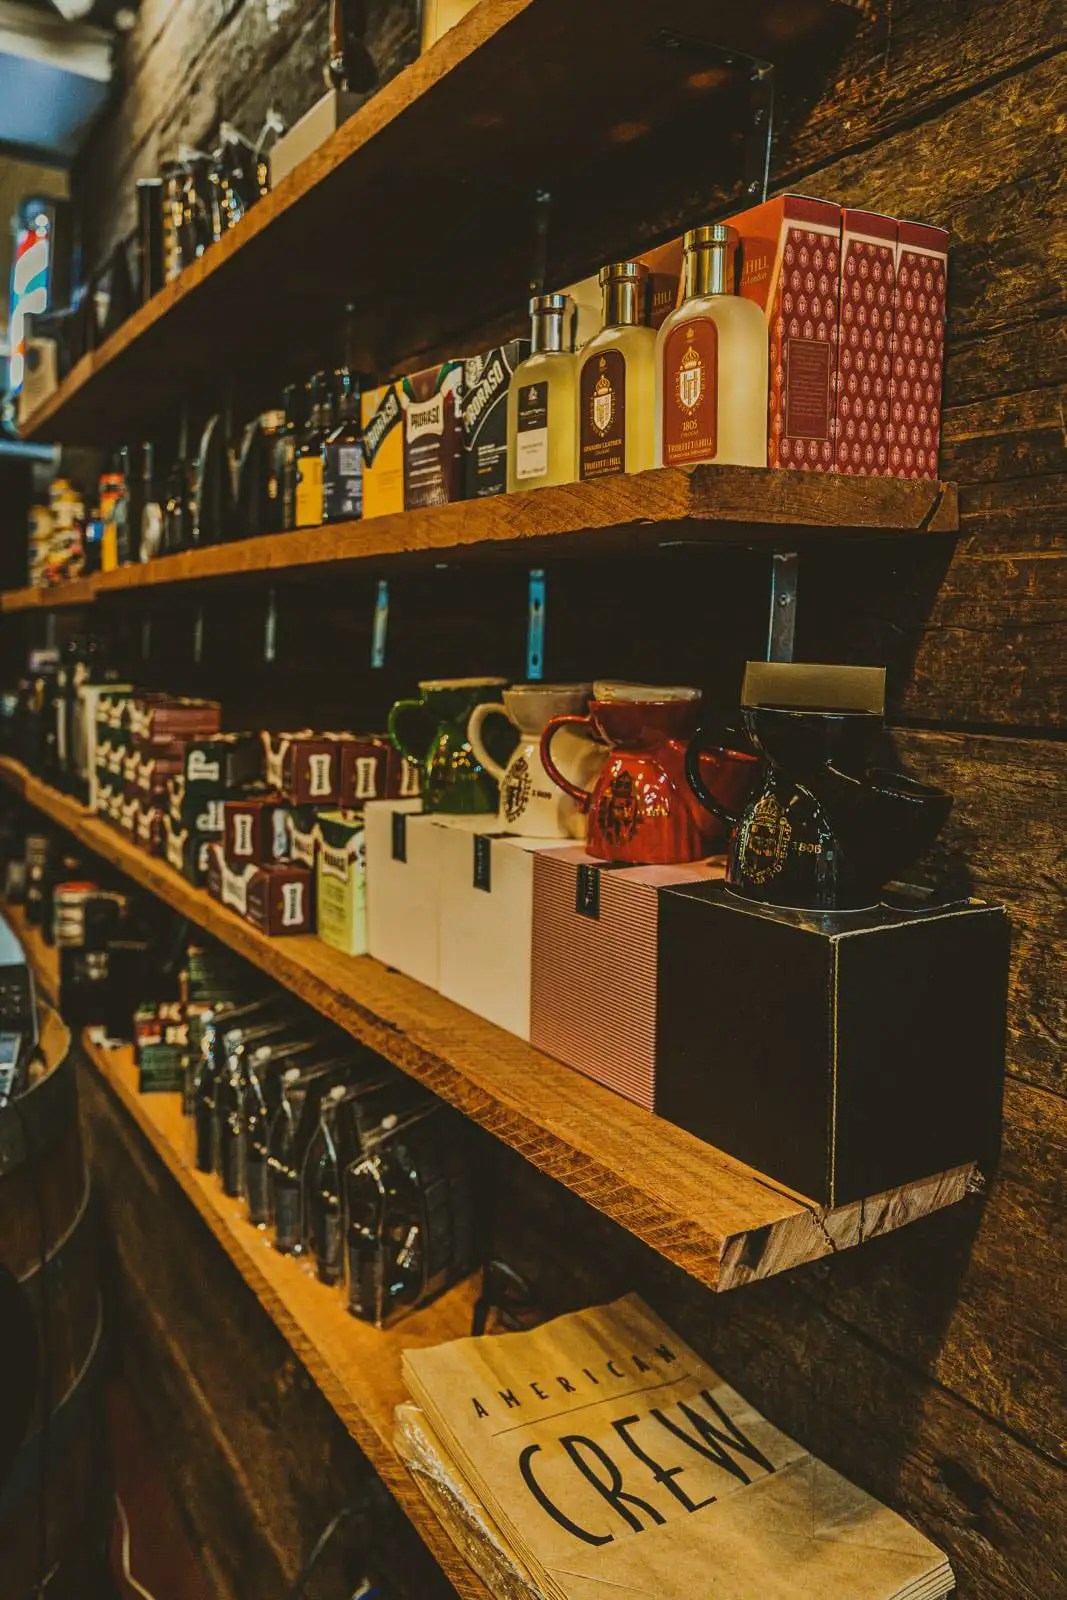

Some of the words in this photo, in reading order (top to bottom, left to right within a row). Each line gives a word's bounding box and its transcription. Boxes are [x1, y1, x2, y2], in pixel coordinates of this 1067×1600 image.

[463, 360, 504, 433] PRORASO
[472, 1343, 677, 1419] AMERICAN
[519, 1389, 777, 1547] CREW
